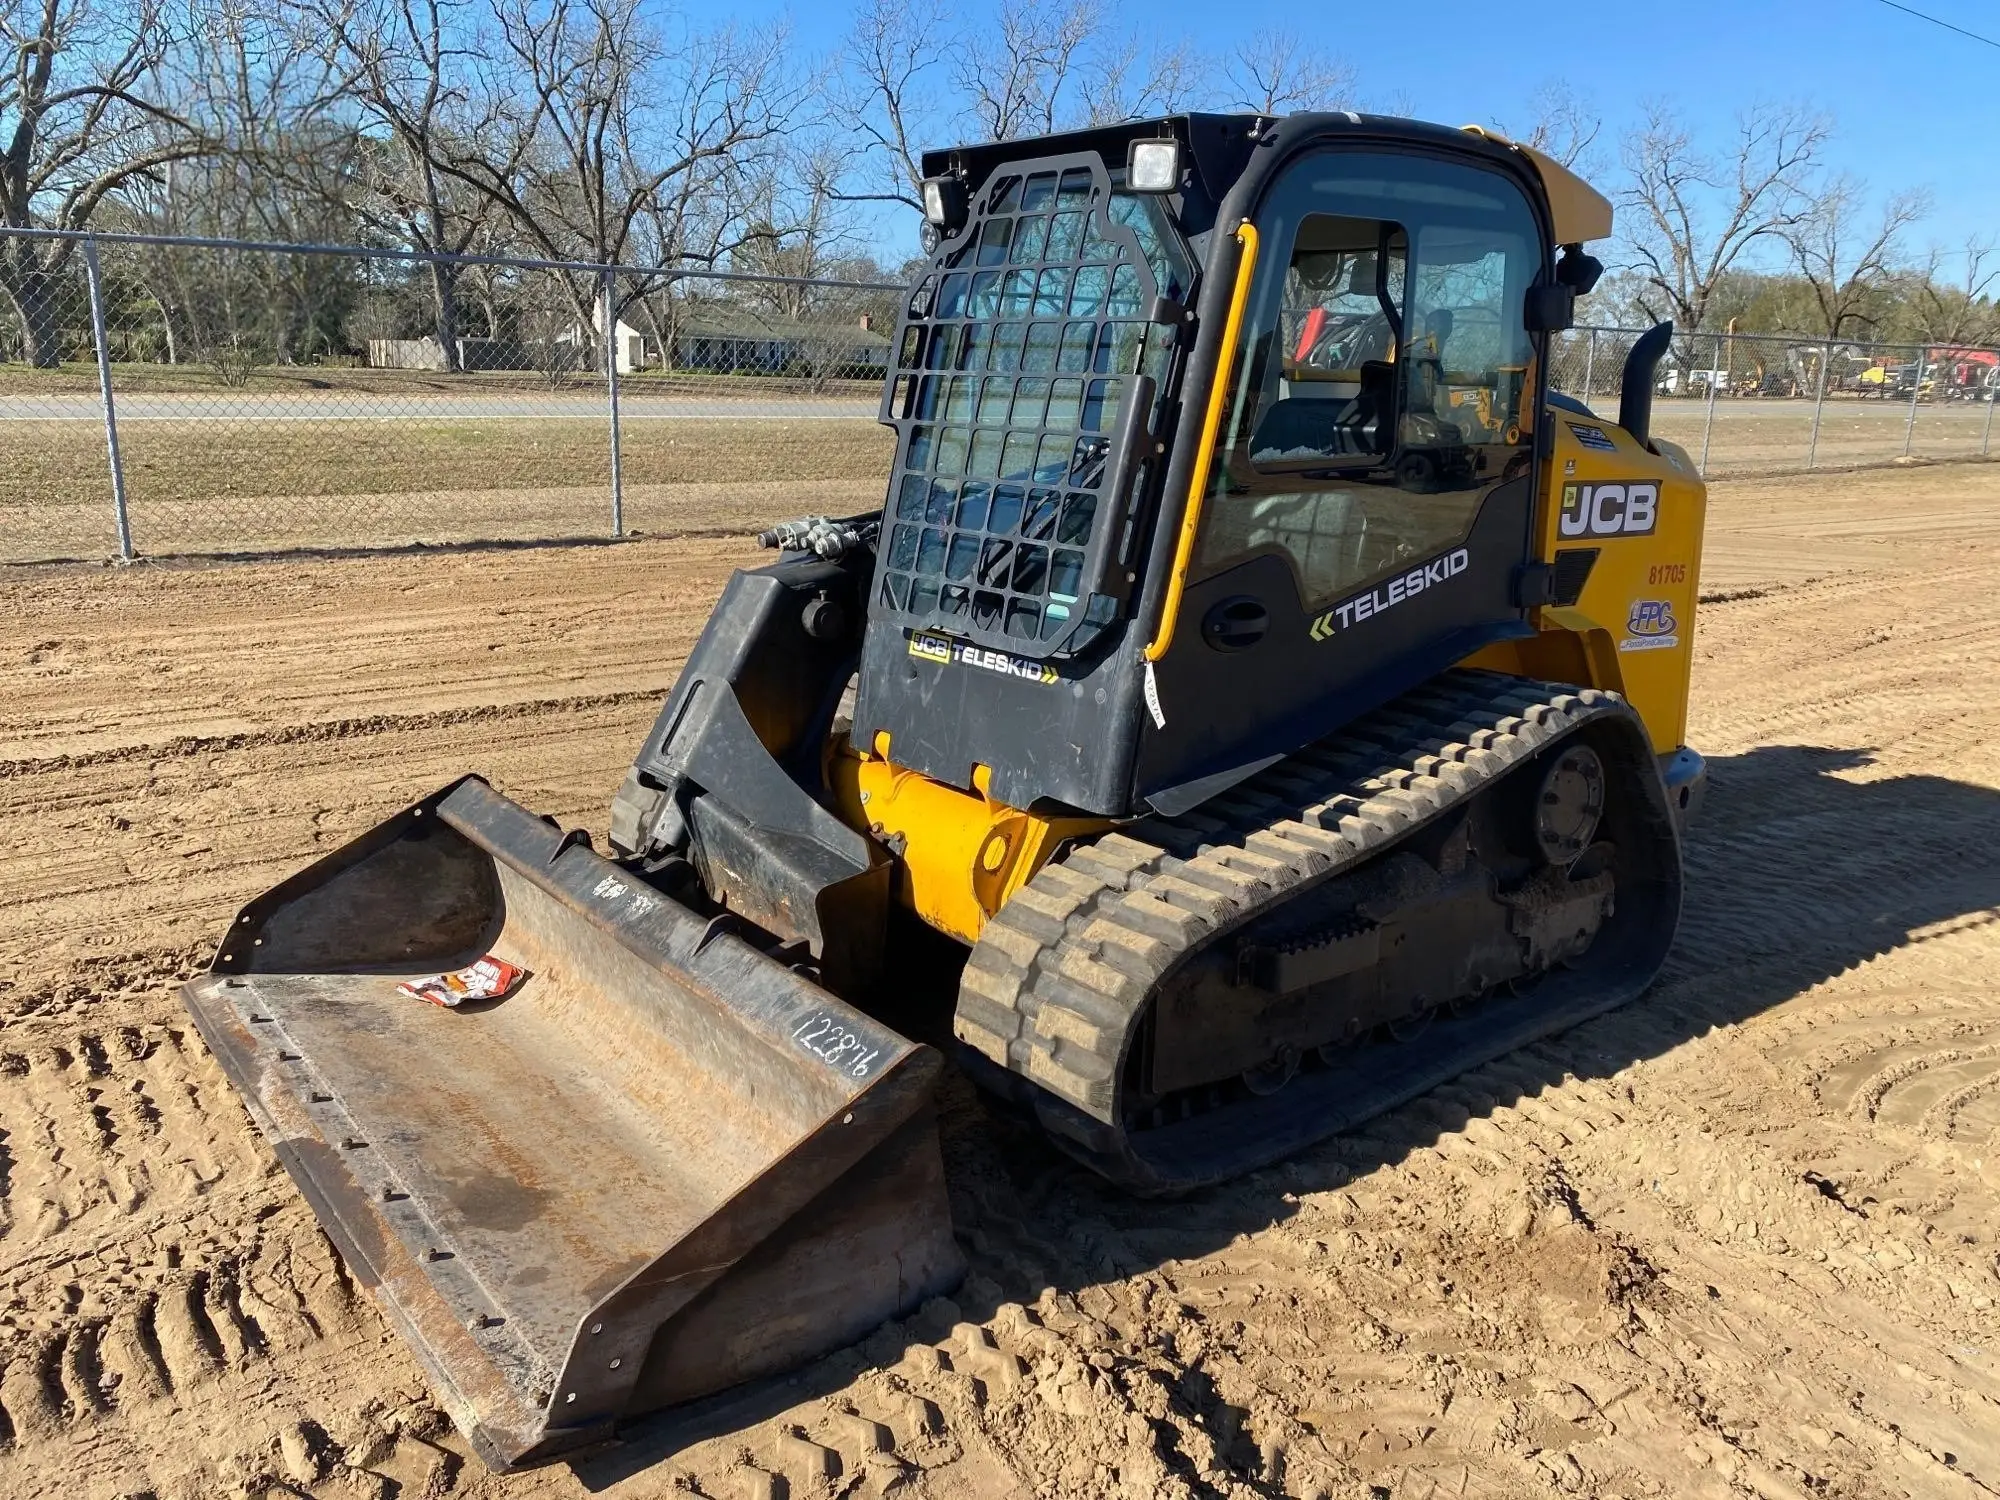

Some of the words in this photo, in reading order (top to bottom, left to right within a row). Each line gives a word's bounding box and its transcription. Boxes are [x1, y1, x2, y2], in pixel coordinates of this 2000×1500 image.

[1561, 484, 1657, 536] JCB
[1335, 548, 1469, 629] TELESKID
[1648, 564, 1686, 585] 81705
[1635, 601, 1673, 630] FPC
[913, 634, 948, 658] JCB
[953, 643, 1042, 681] TELESKID
[791, 1011, 879, 1076] 122876
